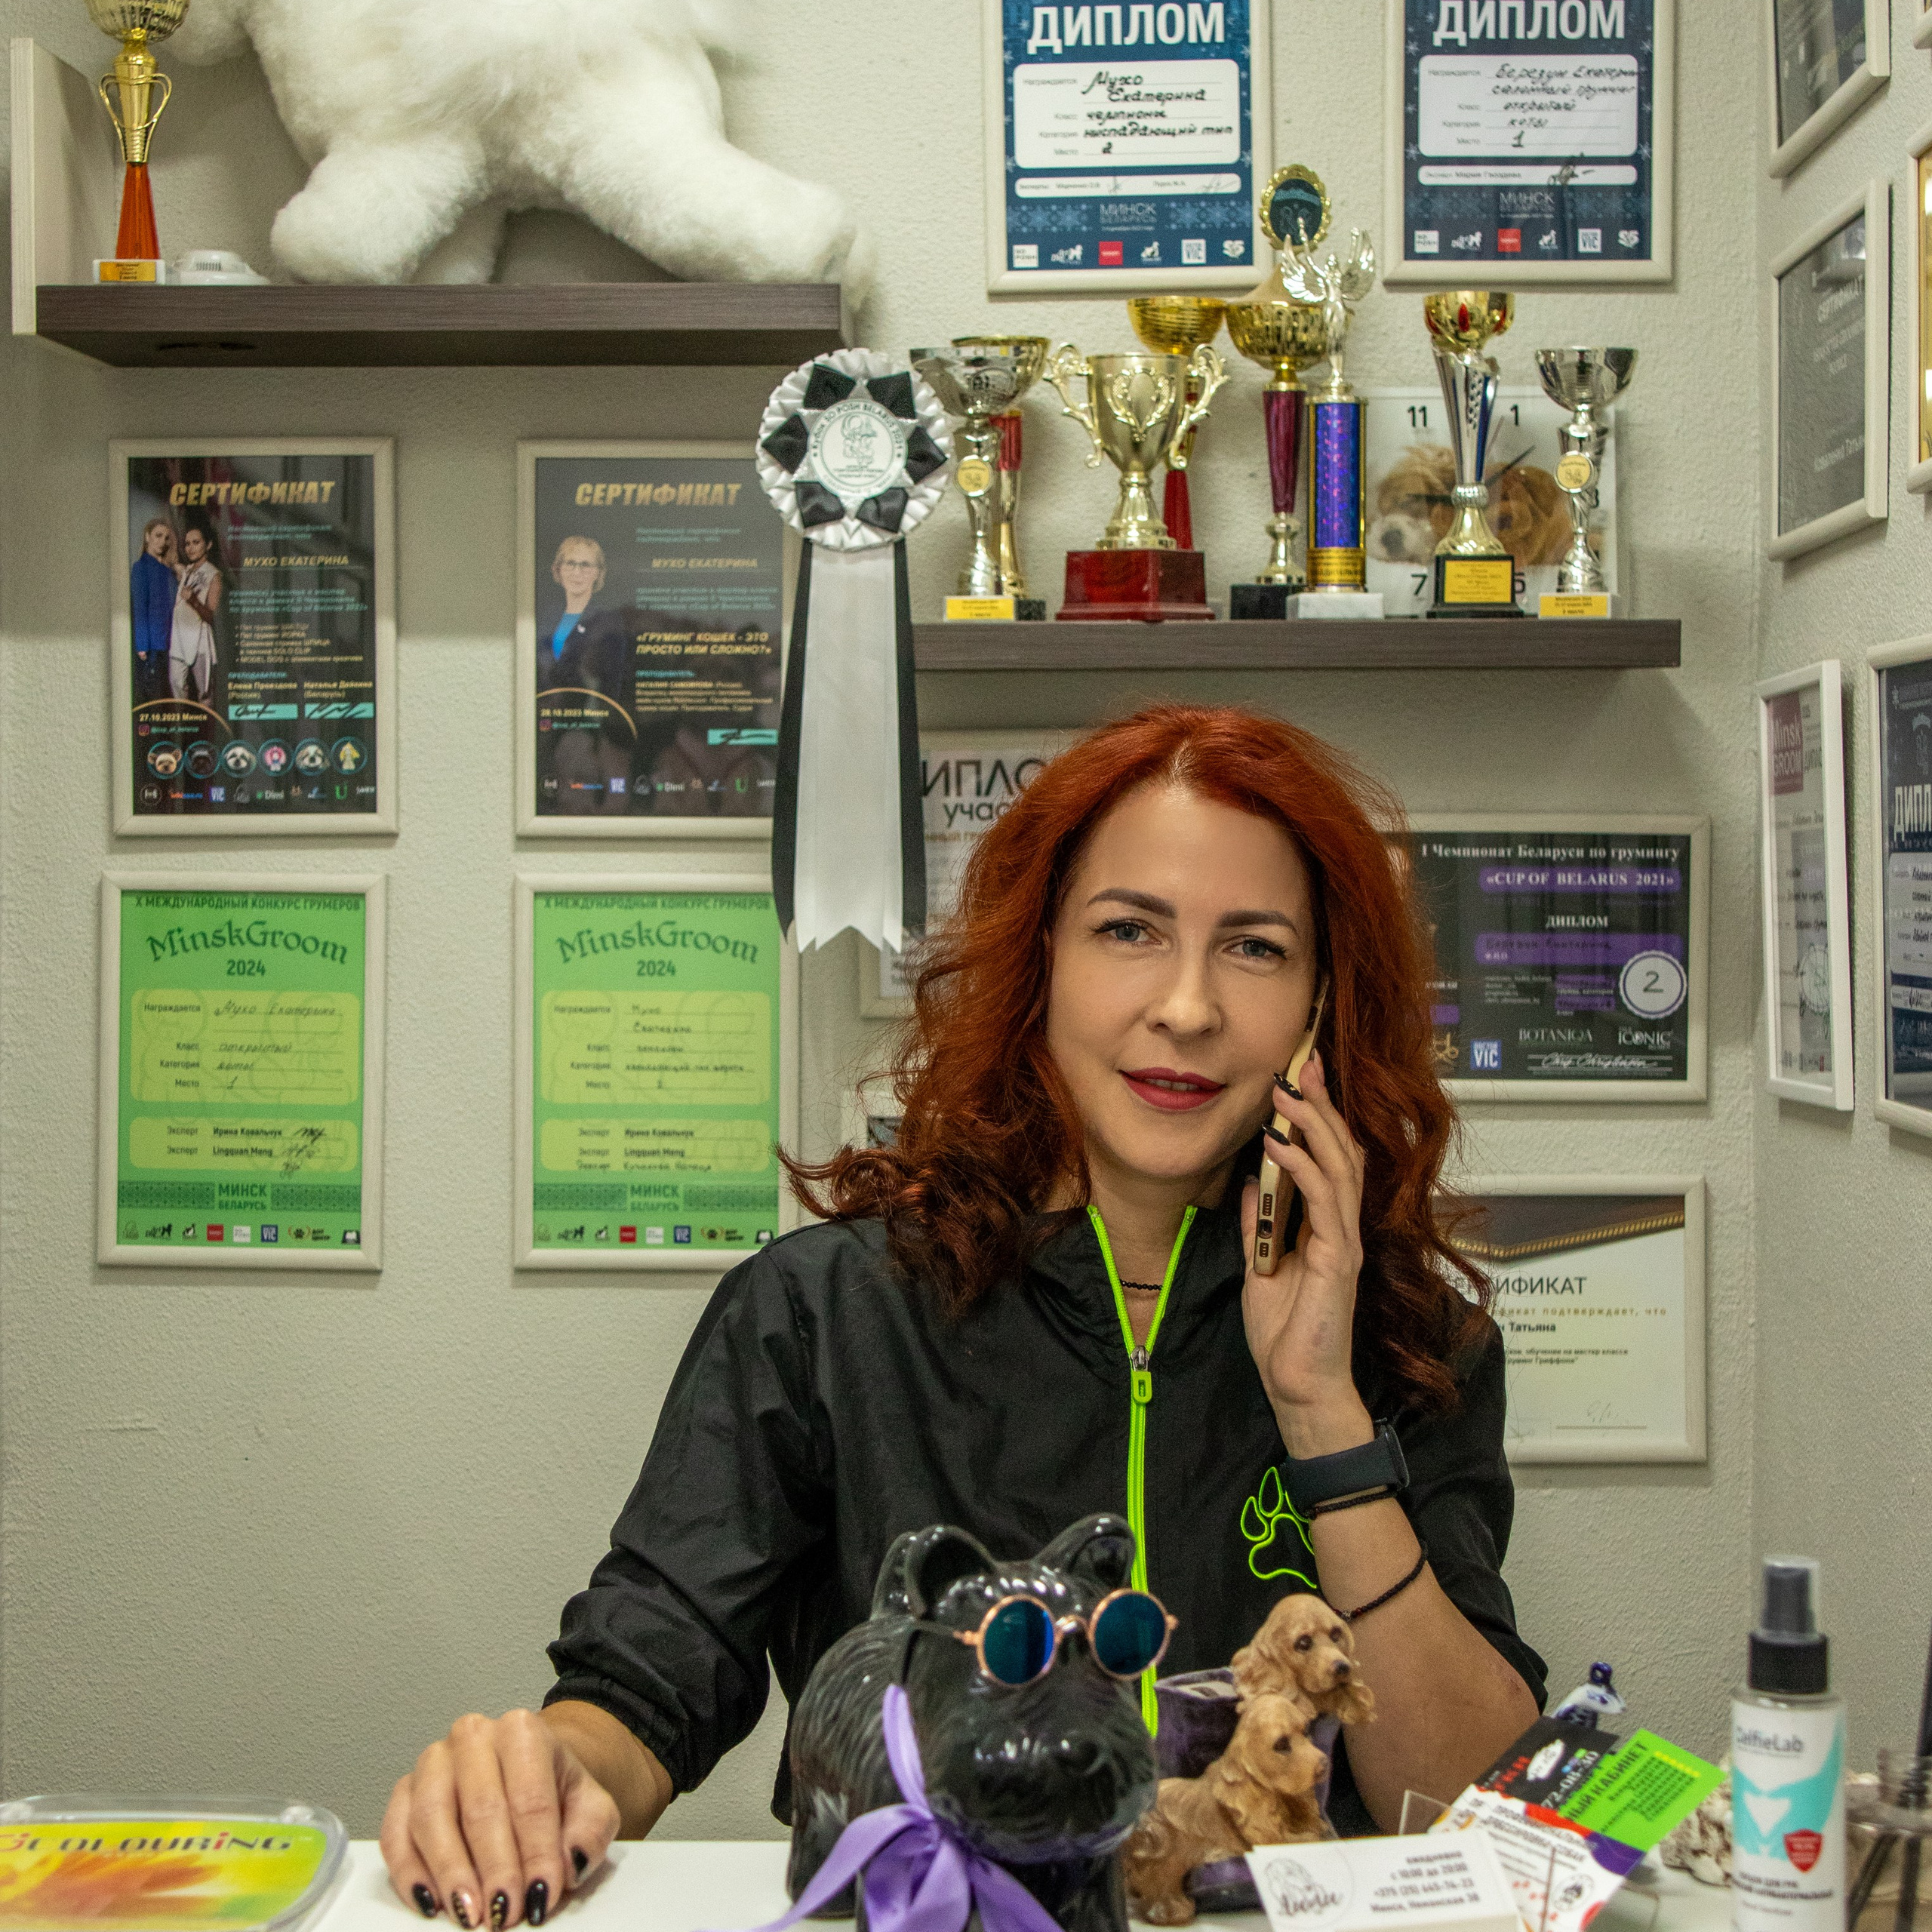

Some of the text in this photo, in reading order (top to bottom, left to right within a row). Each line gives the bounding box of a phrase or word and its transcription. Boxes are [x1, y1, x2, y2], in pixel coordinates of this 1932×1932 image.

[1027, 2, 1225, 54] ДИПЛОМ
[1432, 0, 1624, 46] ДИПЛОМ
[1511, 131, 1524, 148] 1
[1407, 405, 1428, 427] 11
[1510, 405, 1520, 426] 1
[170, 481, 335, 506] СЕРТИФИКАТ
[575, 483, 741, 506] СЕРТИФИКАТ
[243, 555, 349, 567] МУХО ЕКАТЕРИНА
[1411, 574, 1428, 595] 7
[922, 758, 1048, 797] ИПЛО
[944, 803, 1010, 829] учас
[1894, 783, 1932, 842] ДИПЛ
[1433, 845, 1512, 858] Чемпионат
[1518, 844, 1584, 860] Беларуси
[1589, 848, 1606, 858] по
[1611, 846, 1680, 862] грумингу
[1528, 873, 1549, 884] OF
[1557, 872, 1628, 885] BELARUS
[1545, 915, 1609, 929] ДИПЛОМ
[146, 918, 348, 964] MinskGroom
[555, 919, 758, 964] MinskGroom
[226, 959, 266, 977] 2024
[636, 960, 676, 977] 2024
[1642, 971, 1664, 994] 2
[1474, 1050, 1499, 1069] VIC
[213, 1128, 238, 1137] Ирина
[218, 1183, 267, 1198] МИНСК
[1497, 1276, 1587, 1295] ИФИКАТ
[1500, 1306, 1536, 1316] фикат
[1645, 1308, 1667, 1316] что
[1510, 1322, 1556, 1333] Татьяна
[1541, 1750, 1601, 1809] 72-08-30
